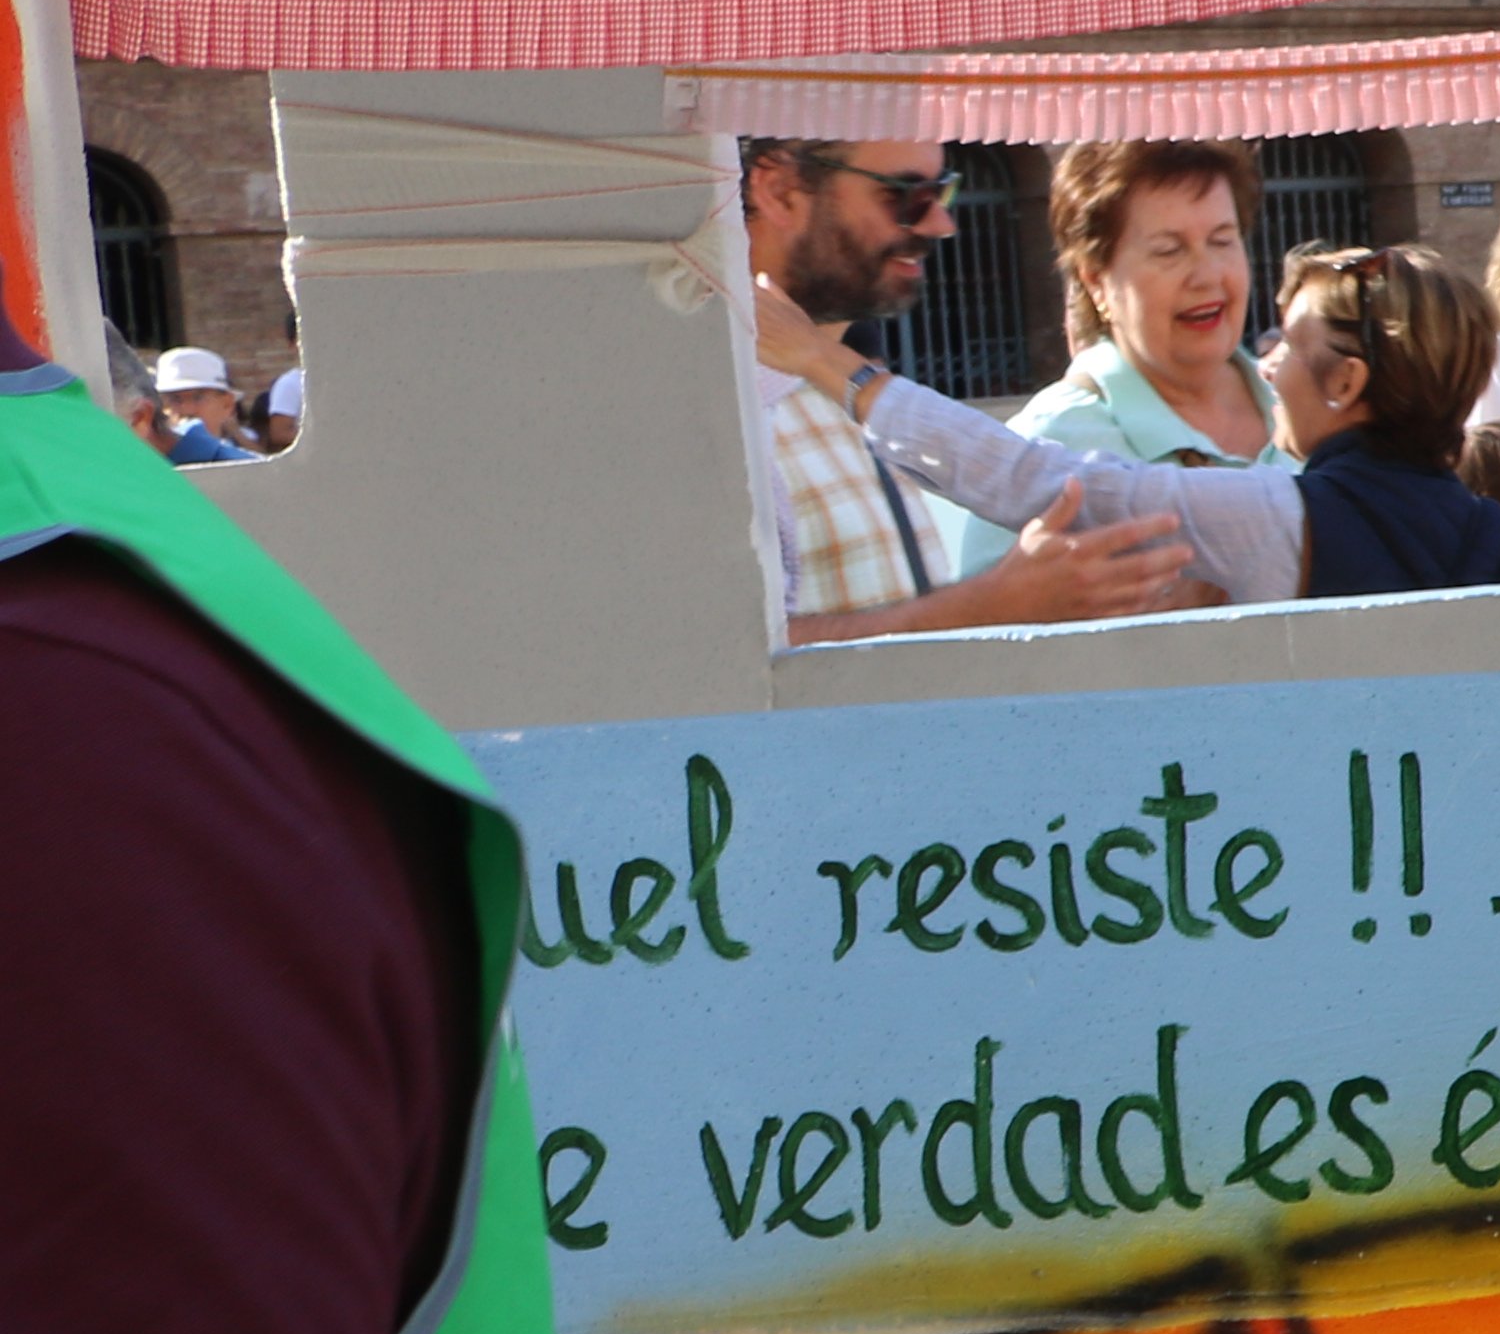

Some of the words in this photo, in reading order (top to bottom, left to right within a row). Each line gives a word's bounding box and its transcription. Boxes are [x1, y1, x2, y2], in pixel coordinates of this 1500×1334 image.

[817, 762, 1290, 962] resiste
[699, 1024, 1204, 1241] verdad
[1224, 1075, 1394, 1203] es
